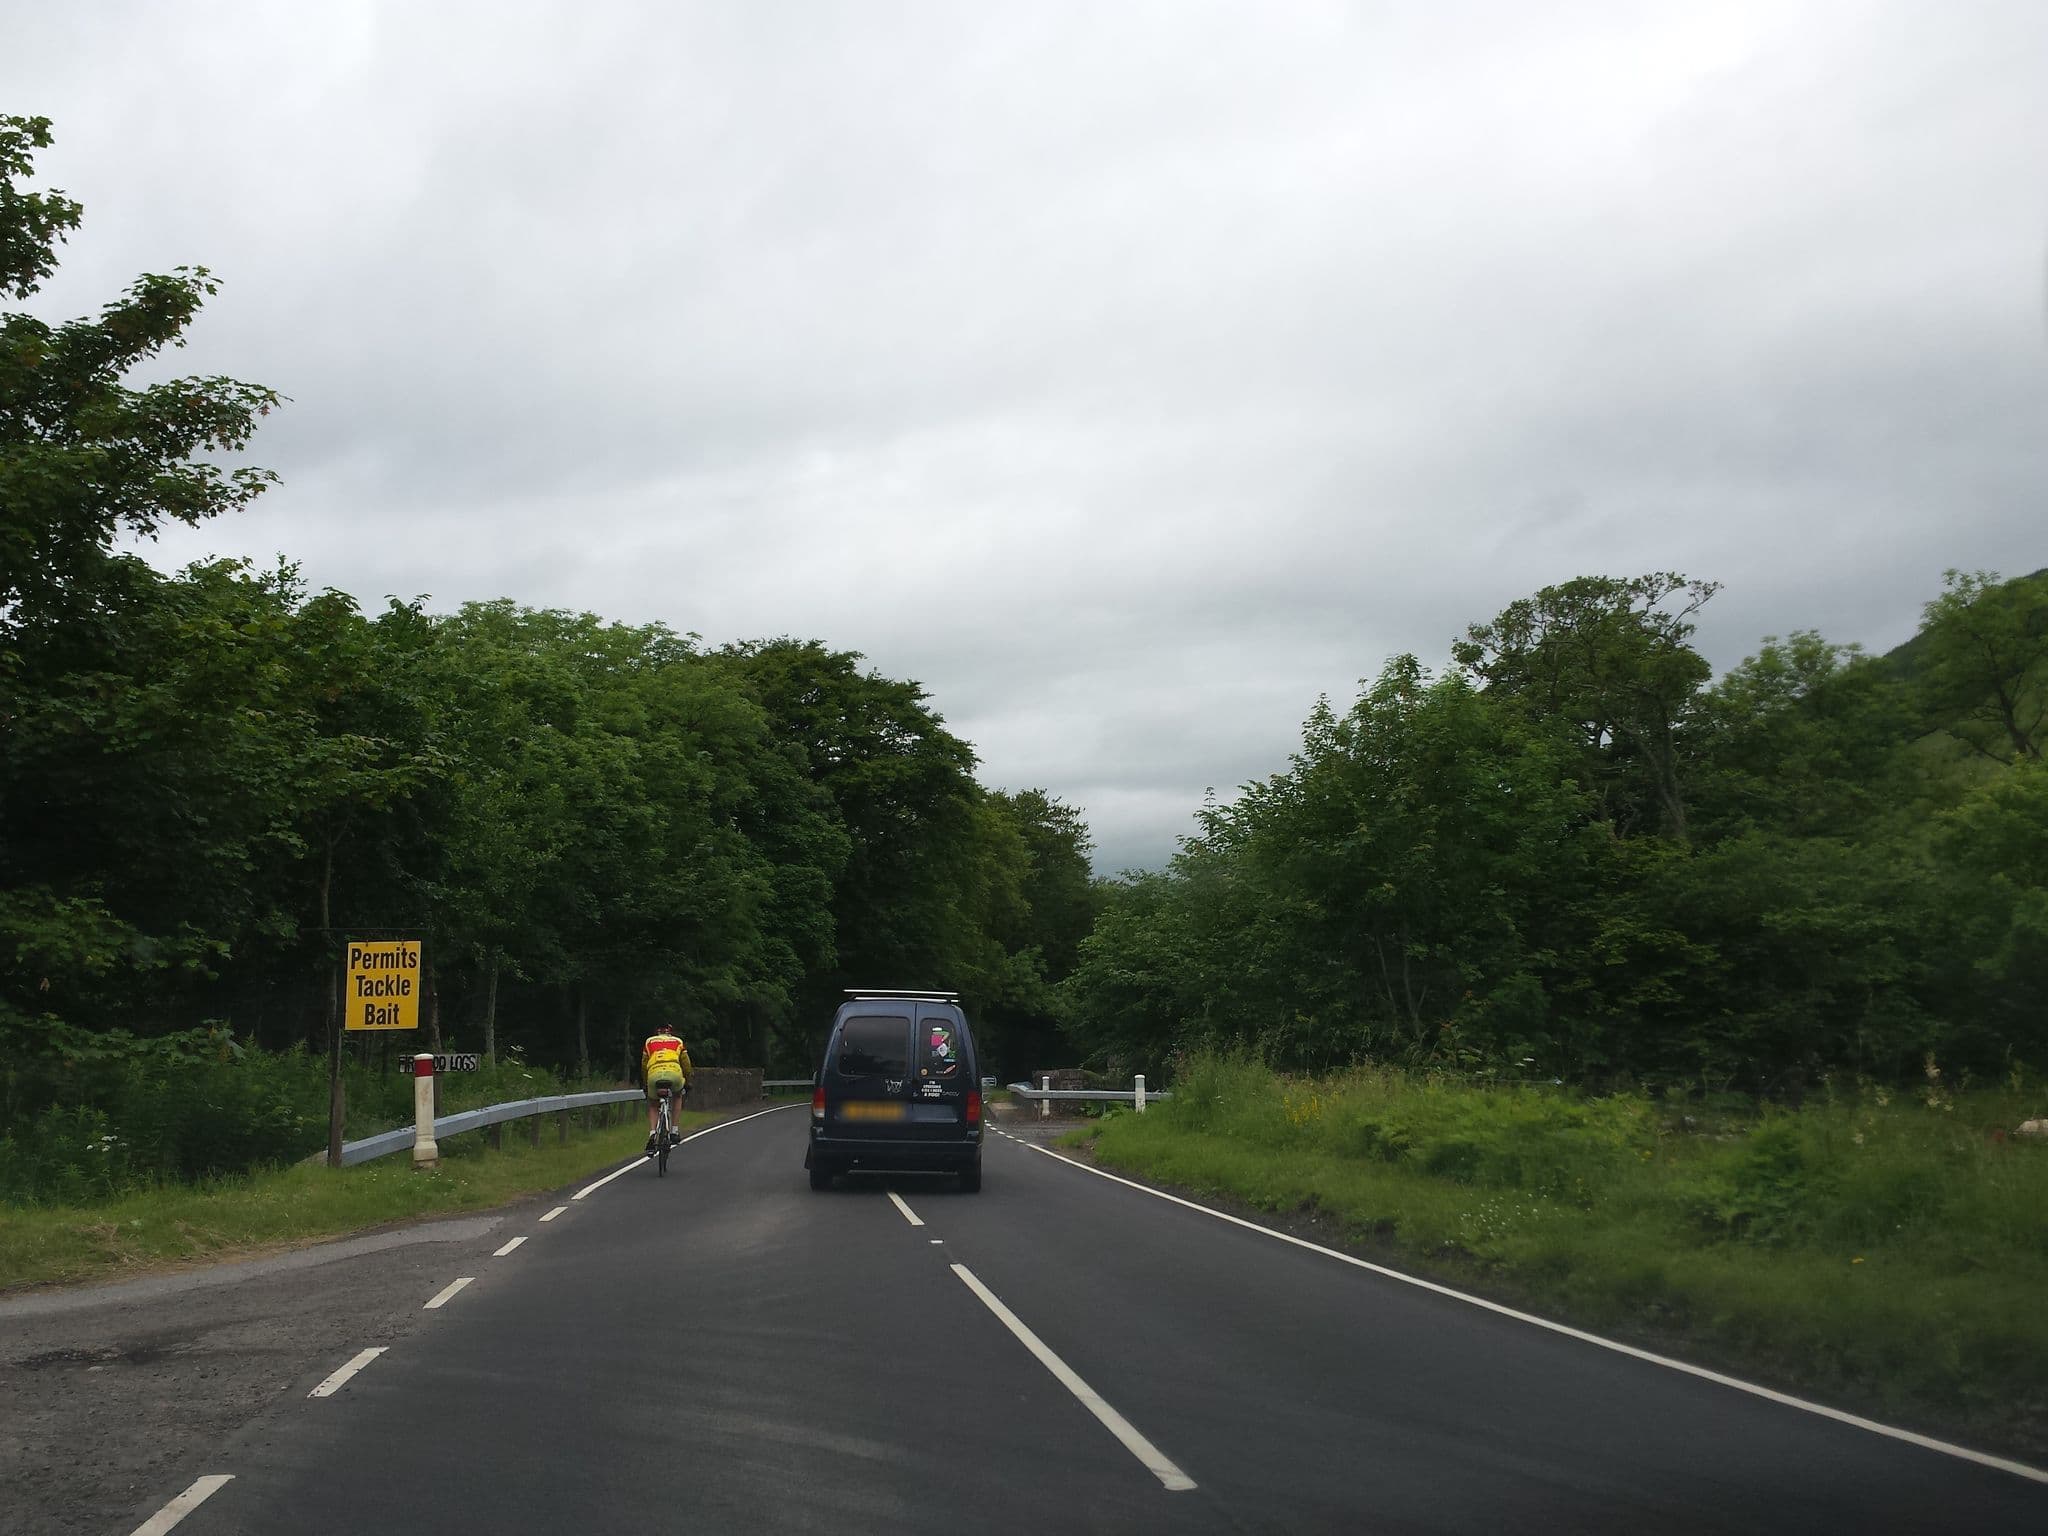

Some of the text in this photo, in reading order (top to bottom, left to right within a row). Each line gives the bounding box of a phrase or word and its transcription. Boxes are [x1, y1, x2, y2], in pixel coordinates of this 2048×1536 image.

[351, 947, 417, 970] Permits
[356, 974, 411, 997] Tackle
[365, 1003, 400, 1025] Bait
[399, 1055, 476, 1073] FIROD LOGS
